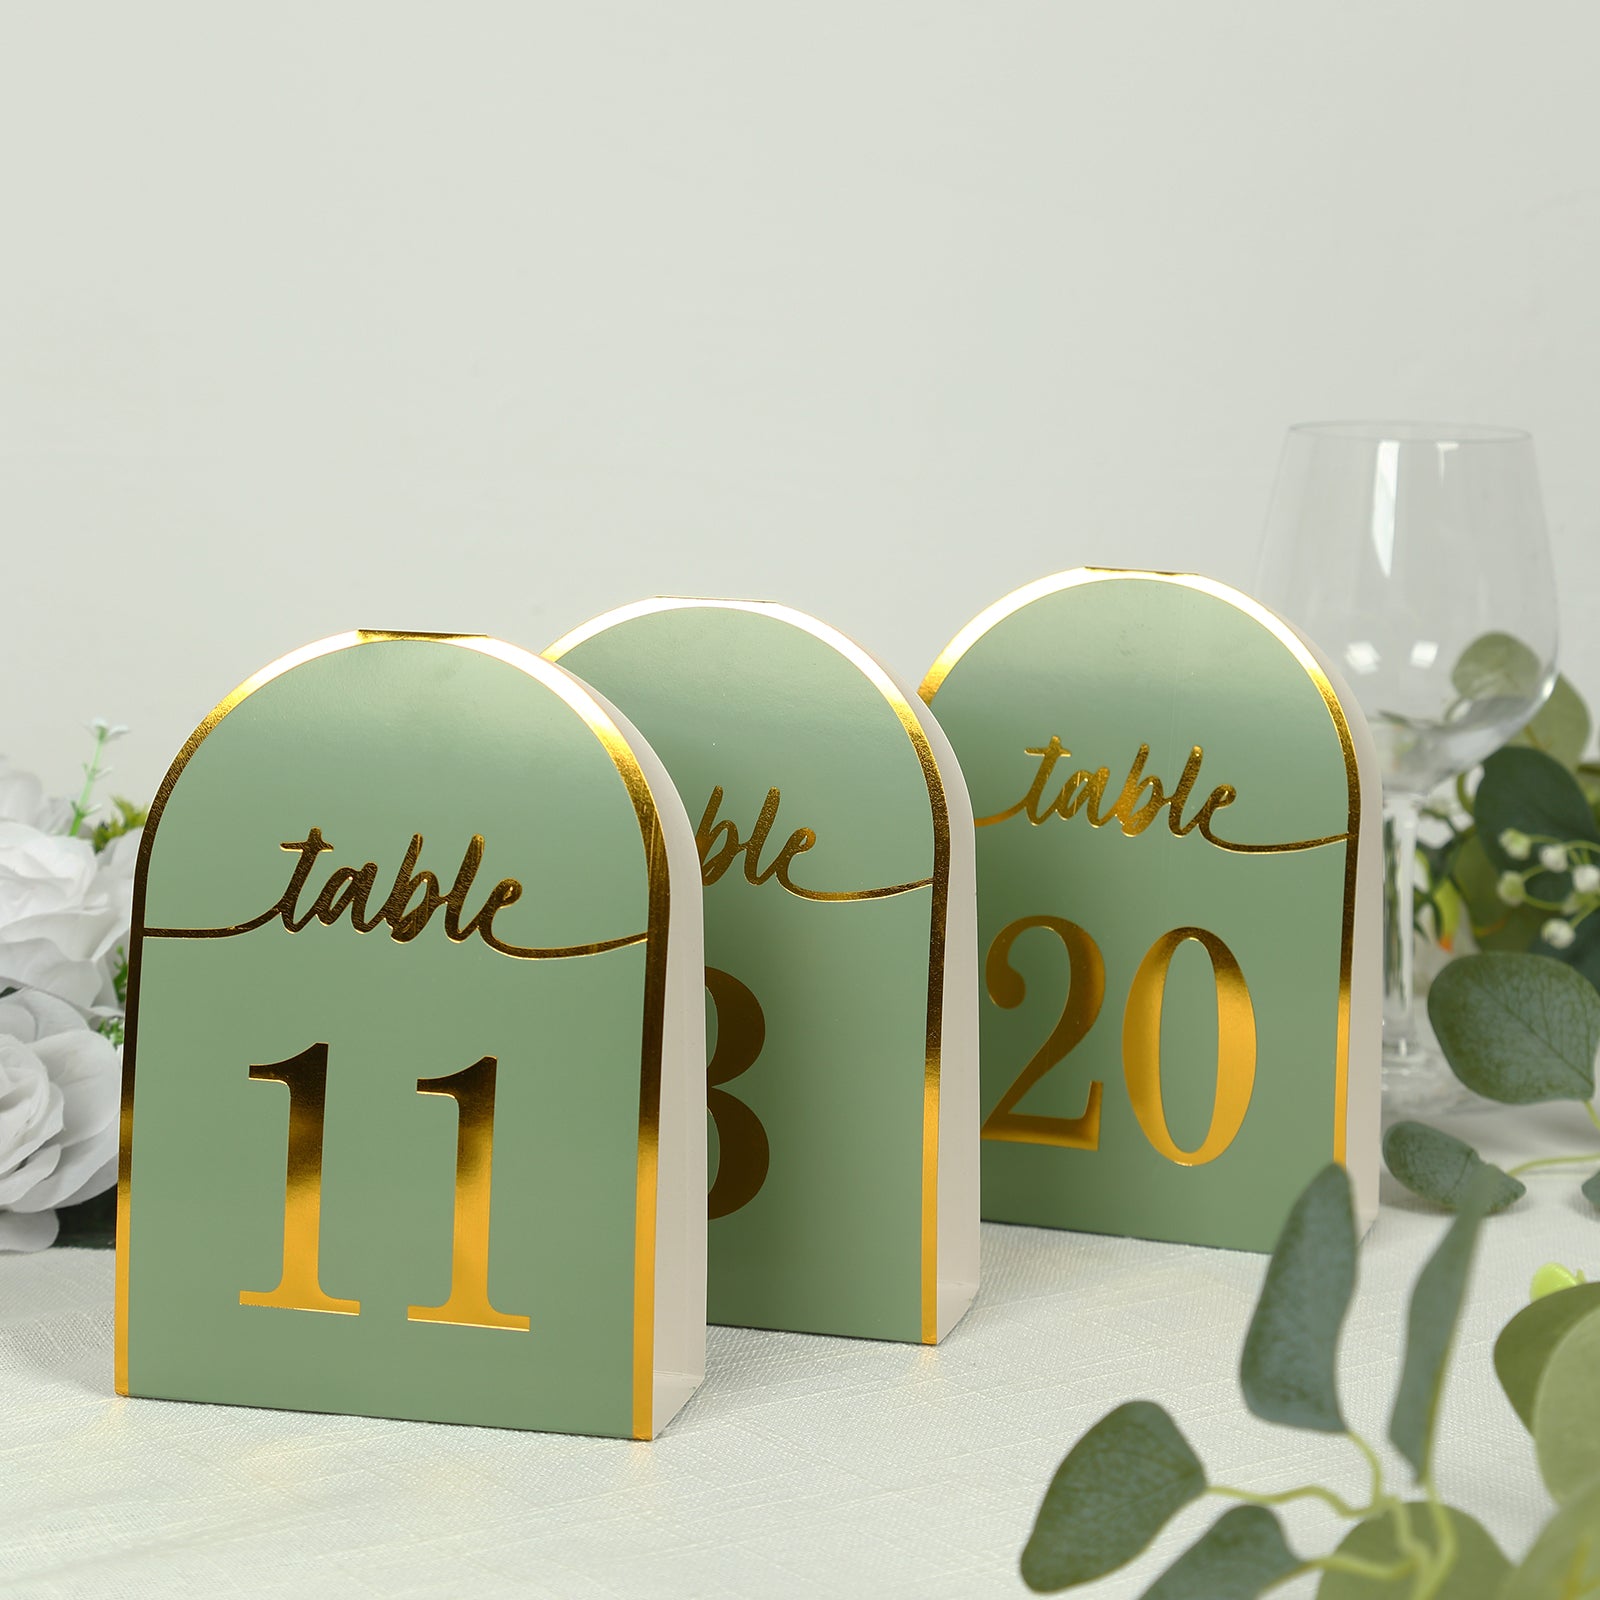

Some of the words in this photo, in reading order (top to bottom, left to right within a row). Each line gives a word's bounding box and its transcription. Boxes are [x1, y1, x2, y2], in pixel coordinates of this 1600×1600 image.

[695, 785, 855, 902] ble
[990, 736, 1275, 854] table
[235, 827, 580, 960] table
[980, 914, 1258, 1167] 20
[239, 1042, 531, 1332] 11
